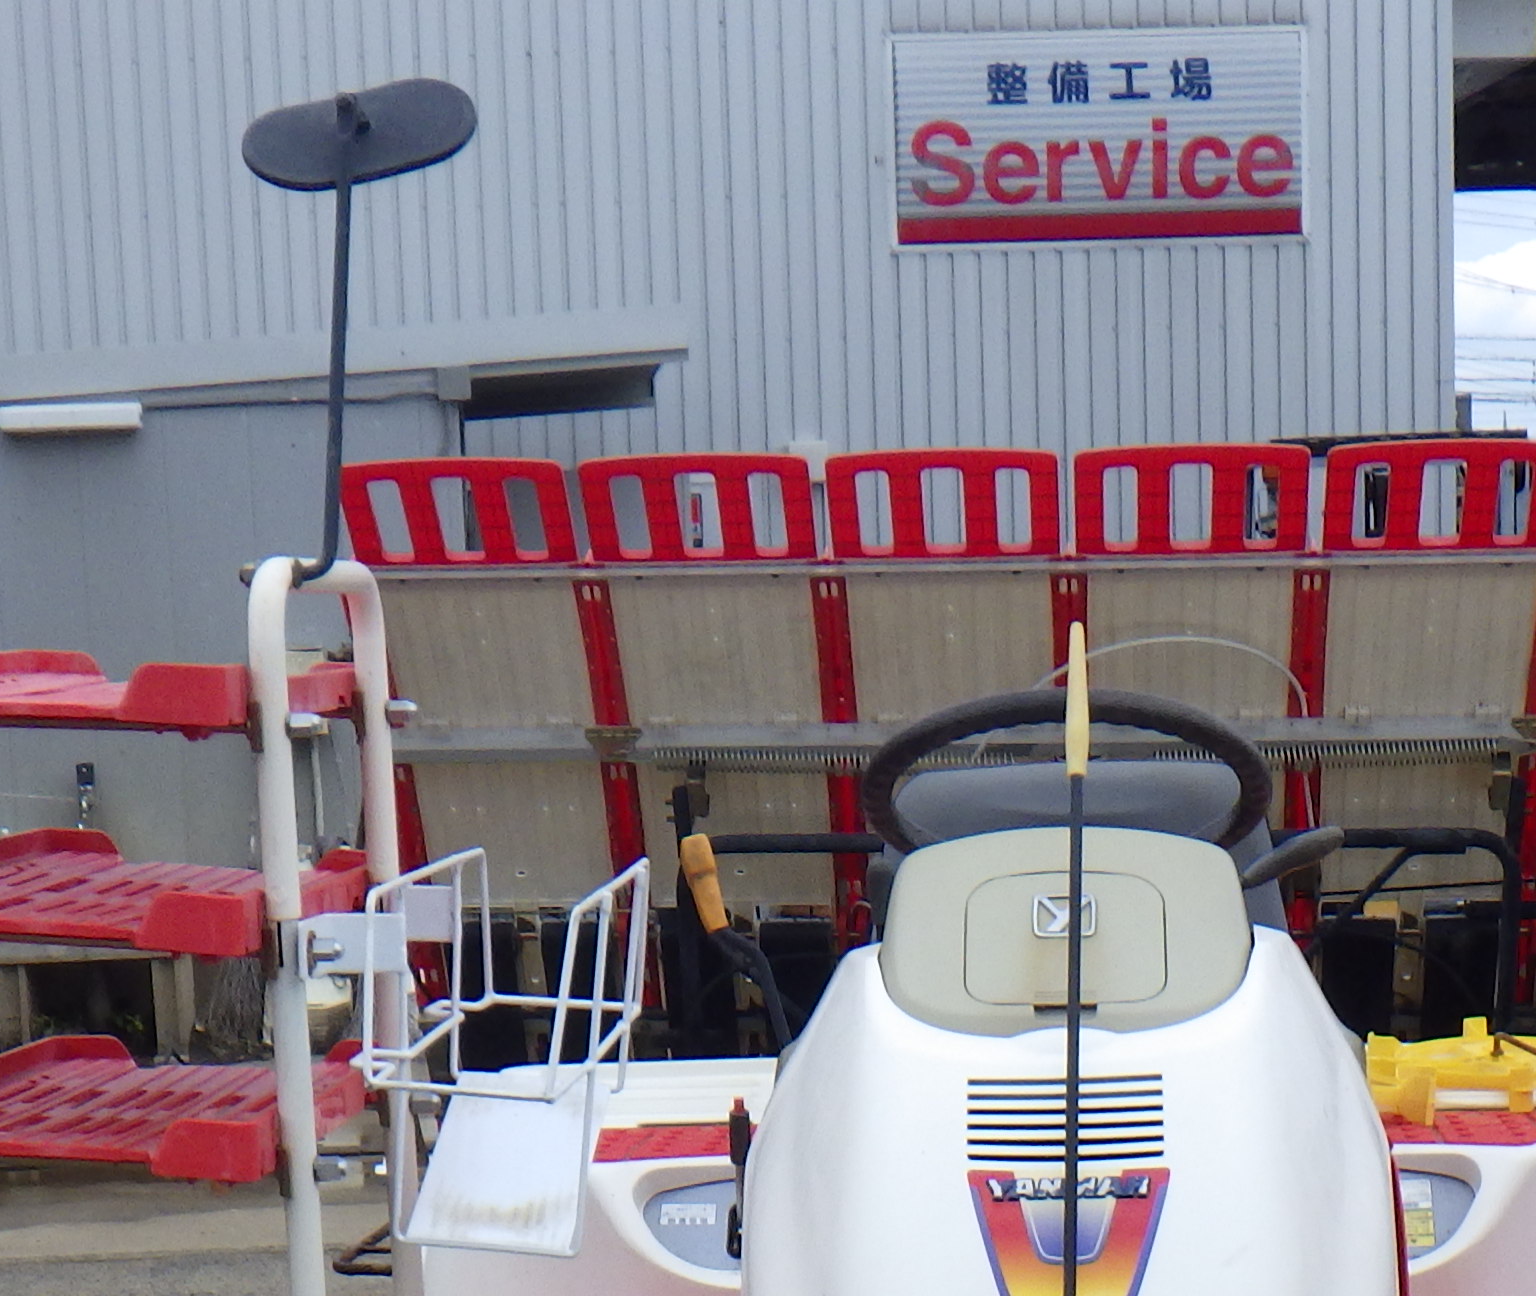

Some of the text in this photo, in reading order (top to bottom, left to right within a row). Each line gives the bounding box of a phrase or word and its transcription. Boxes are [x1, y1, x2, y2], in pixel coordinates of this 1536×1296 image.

[986, 57, 1213, 105] 整備工場
[910, 117, 1294, 206] Service
